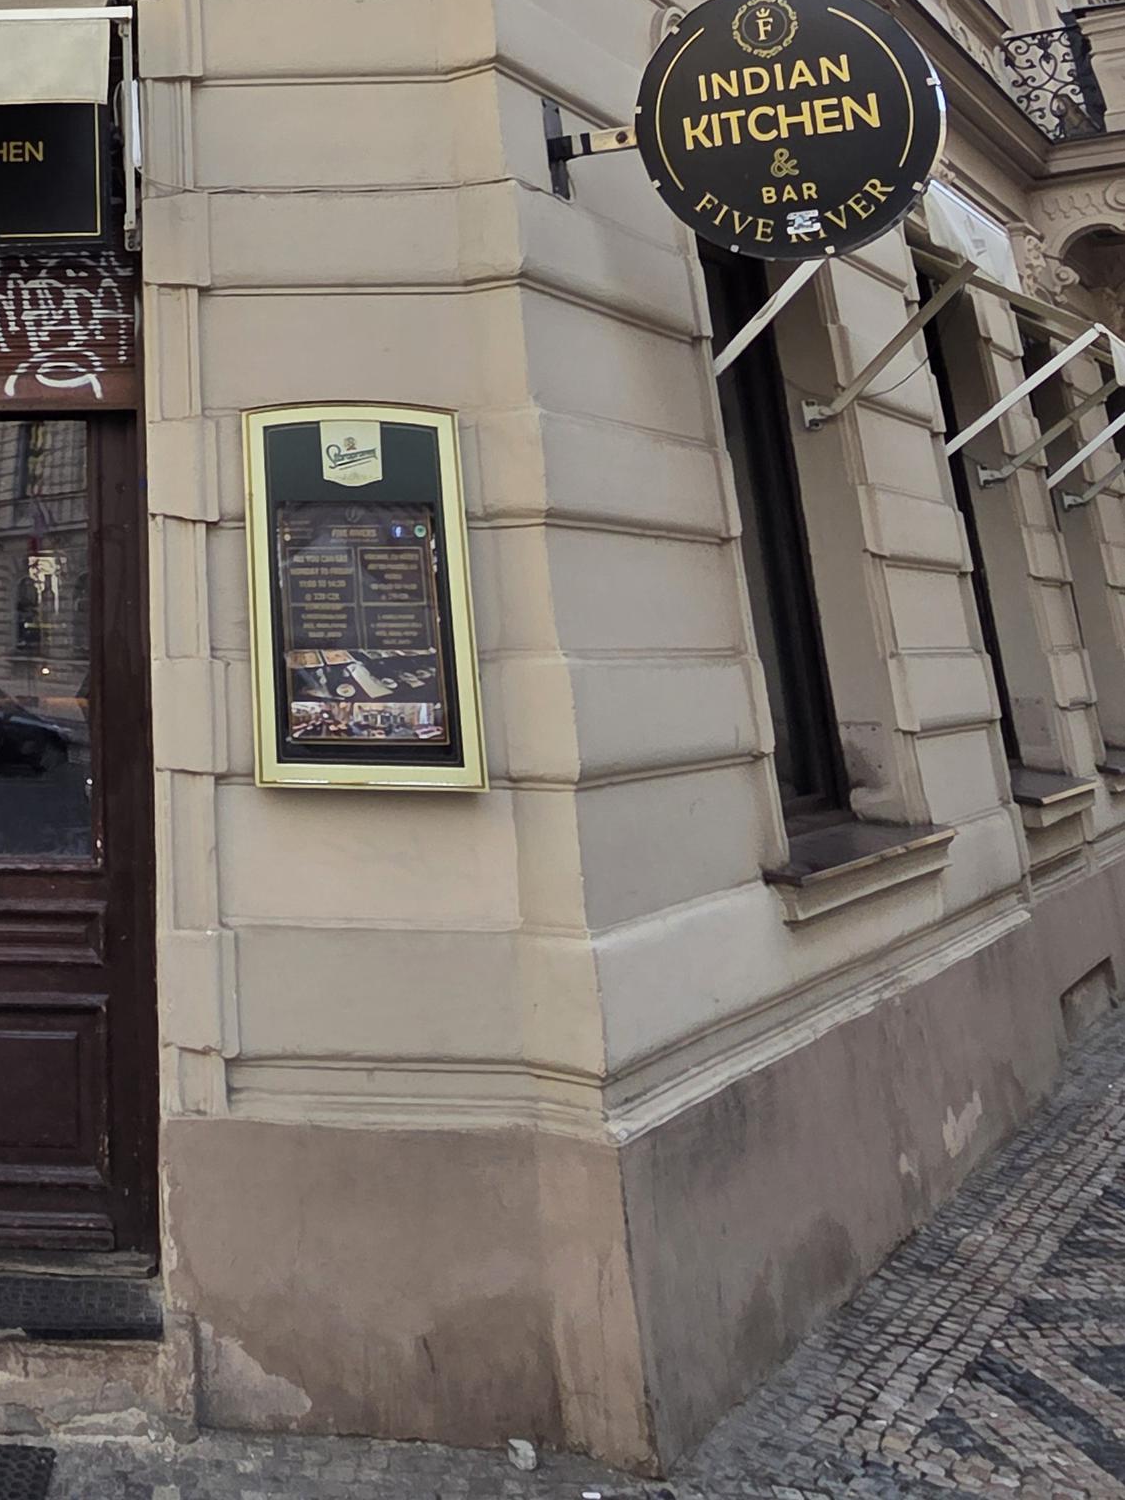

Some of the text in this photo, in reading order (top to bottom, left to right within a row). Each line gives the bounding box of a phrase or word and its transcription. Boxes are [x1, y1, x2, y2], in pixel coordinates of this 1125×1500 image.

[755, 17, 773, 41] F
[697, 54, 851, 101] INDIAN
[682, 92, 881, 151] KITCHEN
[770, 148, 800, 178] &
[761, 182, 819, 204] BAR
[693, 191, 775, 243] FIVE
